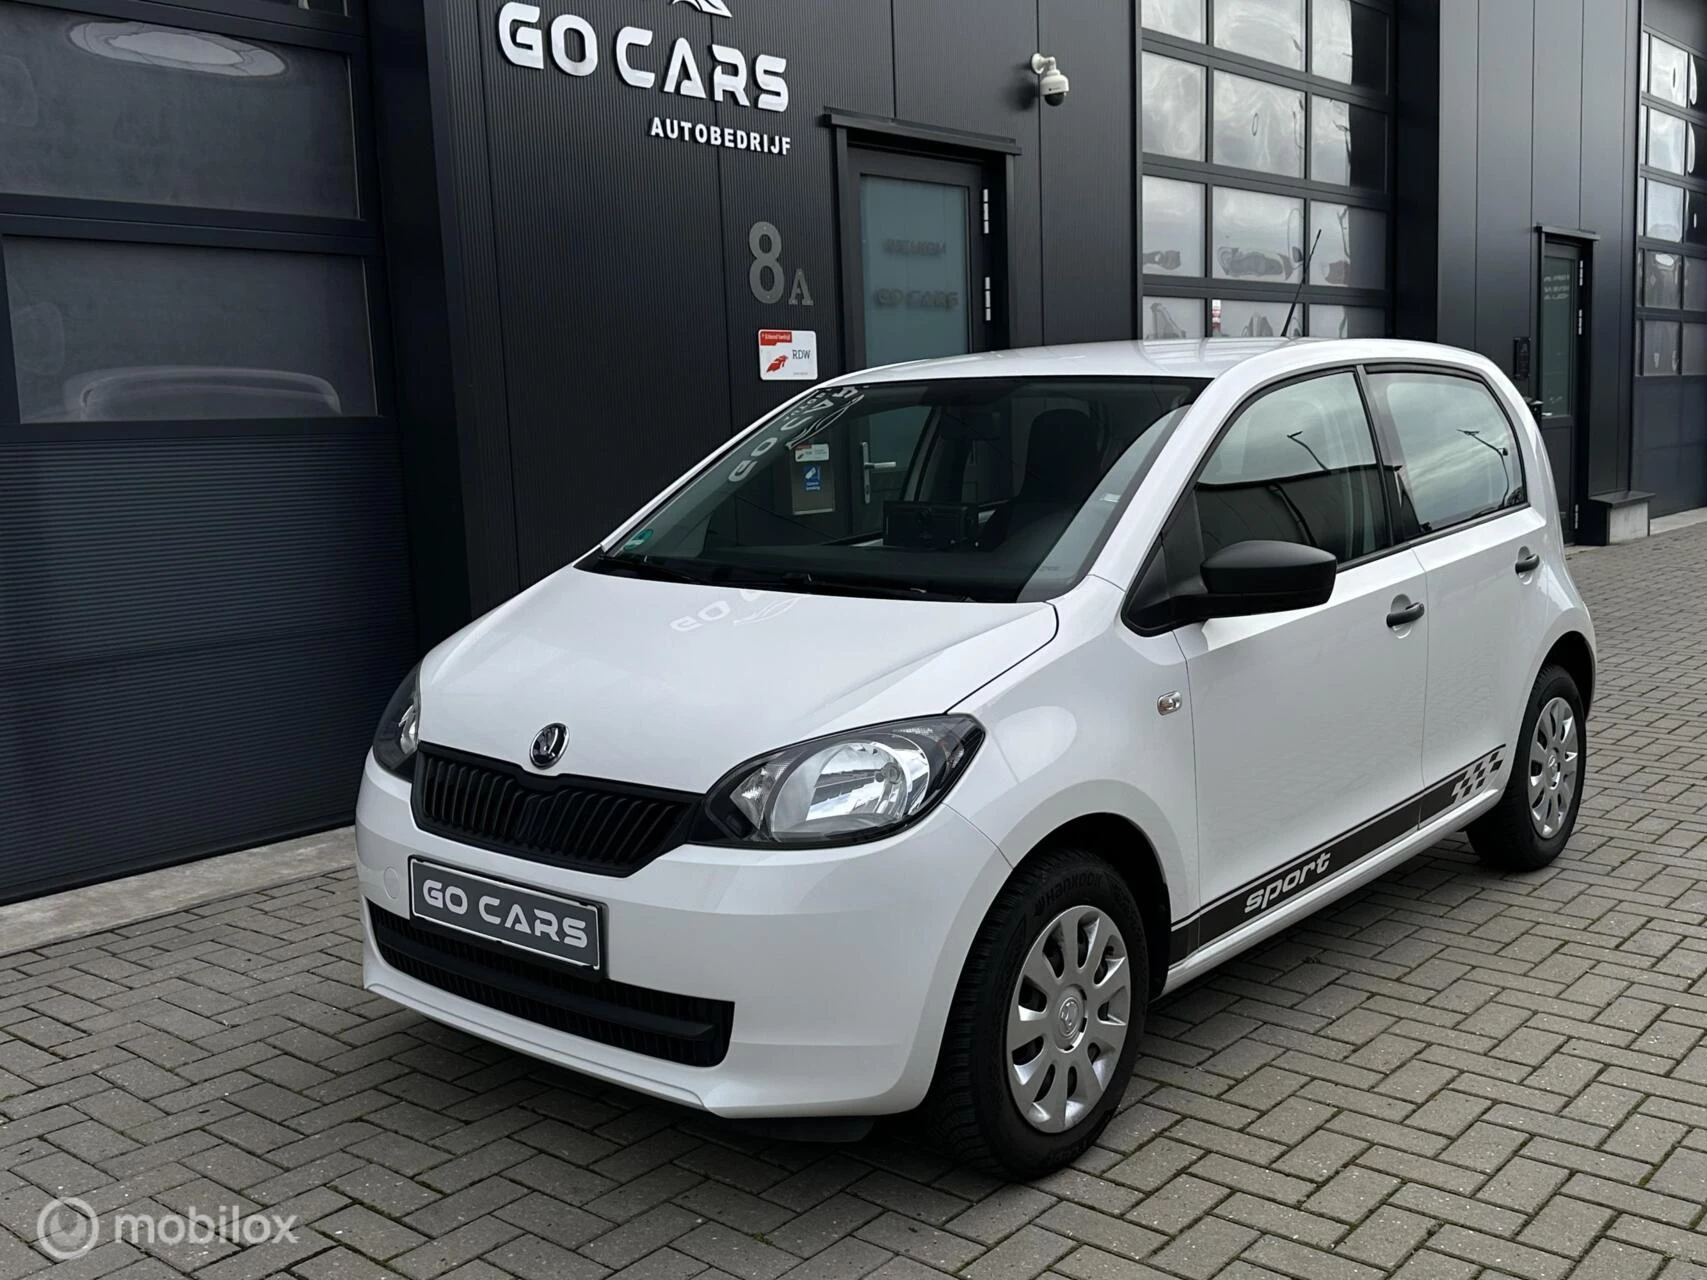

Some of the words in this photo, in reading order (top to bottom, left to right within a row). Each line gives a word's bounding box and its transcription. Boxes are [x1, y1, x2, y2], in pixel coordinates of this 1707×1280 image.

[499, 2, 598, 77] GO
[616, 26, 789, 112] CARS
[650, 117, 791, 155] AUTOBEDRIJF
[792, 349, 811, 360] RDW
[1244, 852, 1331, 913] sport
[422, 879, 468, 915] GO
[478, 895, 588, 948] CARS
